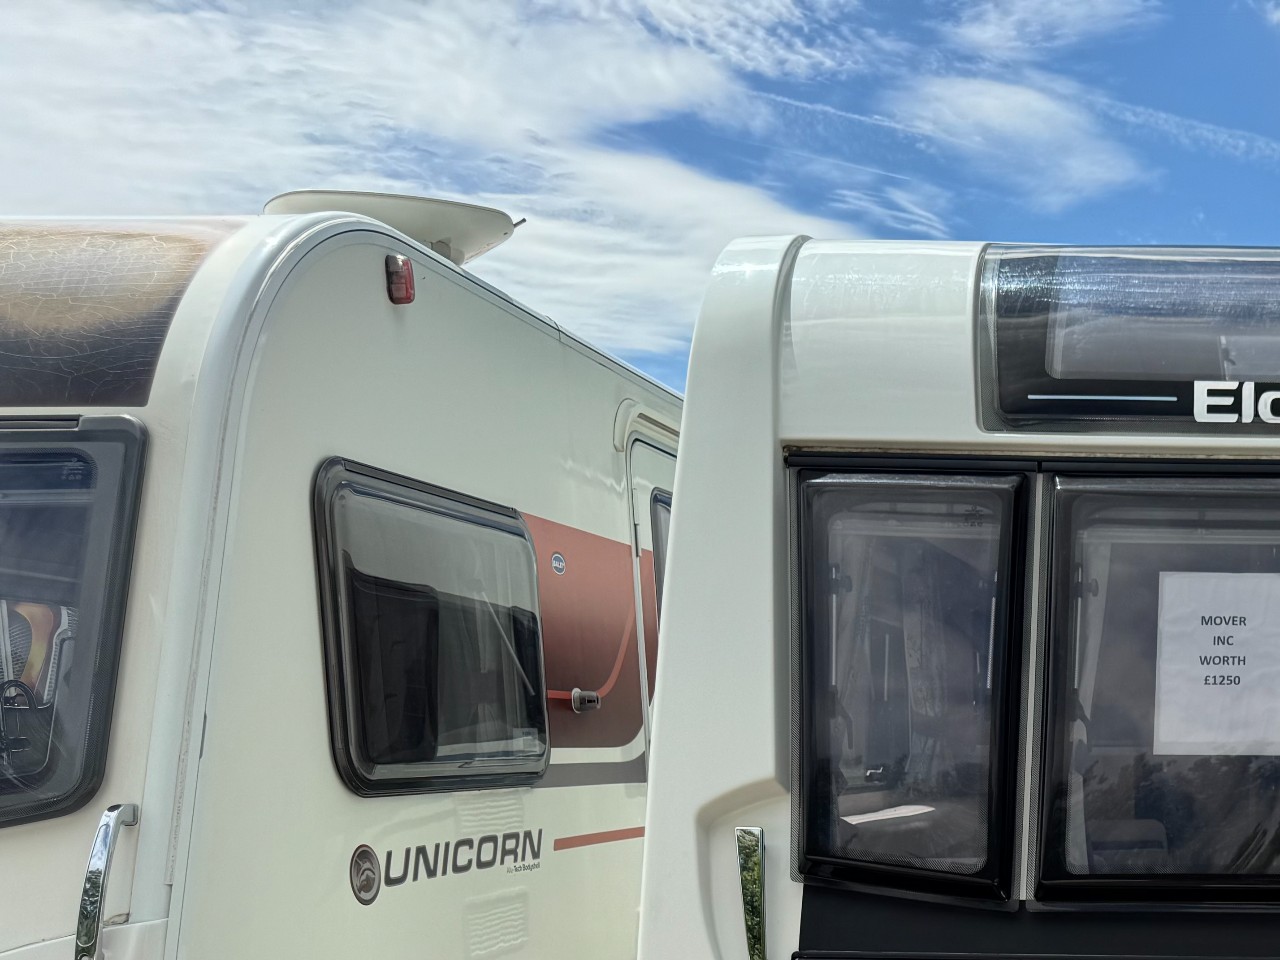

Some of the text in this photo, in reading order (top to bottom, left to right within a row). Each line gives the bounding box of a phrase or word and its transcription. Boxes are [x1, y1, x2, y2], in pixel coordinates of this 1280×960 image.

[1201, 616, 1246, 626] MOVER
[1213, 635, 1234, 646] INC
[1199, 655, 1246, 666] WORTH
[1204, 675, 1241, 686] £1250
[384, 828, 543, 887] UNICORN
